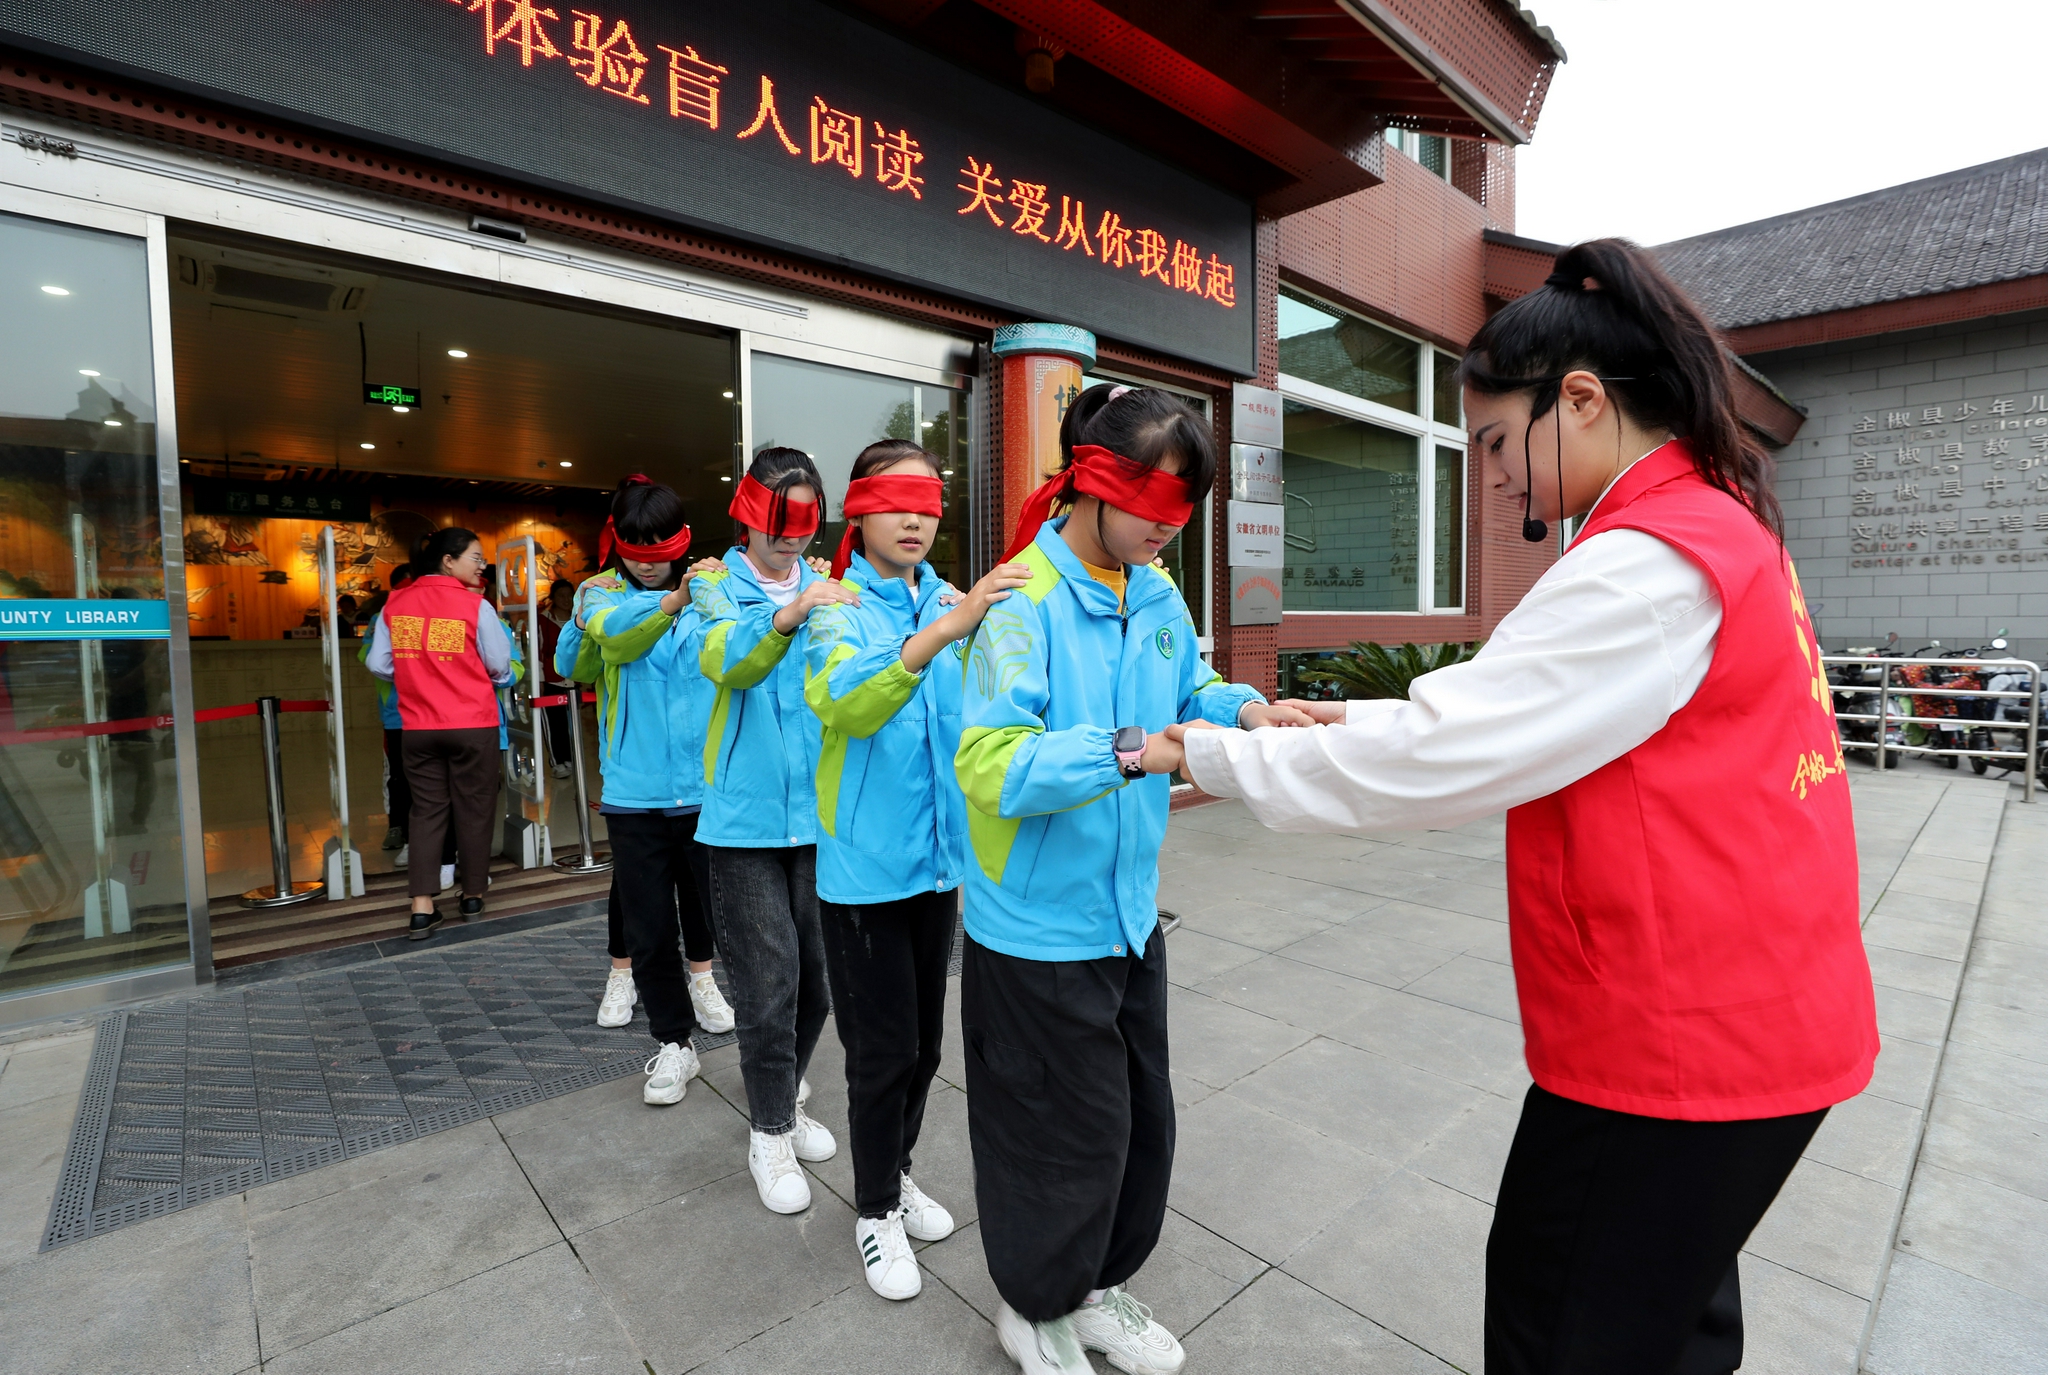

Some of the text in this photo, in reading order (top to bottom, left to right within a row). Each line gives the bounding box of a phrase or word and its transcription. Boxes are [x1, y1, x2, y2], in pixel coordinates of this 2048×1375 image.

[467, 0, 1236, 309] 体验盲人阅读 关爱从你我做起
[255, 494, 343, 510] 服务总台
[1236, 522, 1280, 536] 安徽省文明单位
[1920, 554, 1941, 567] at
[1951, 551, 1985, 566] the
[1, 611, 140, 624] UNTY LIBRARY
